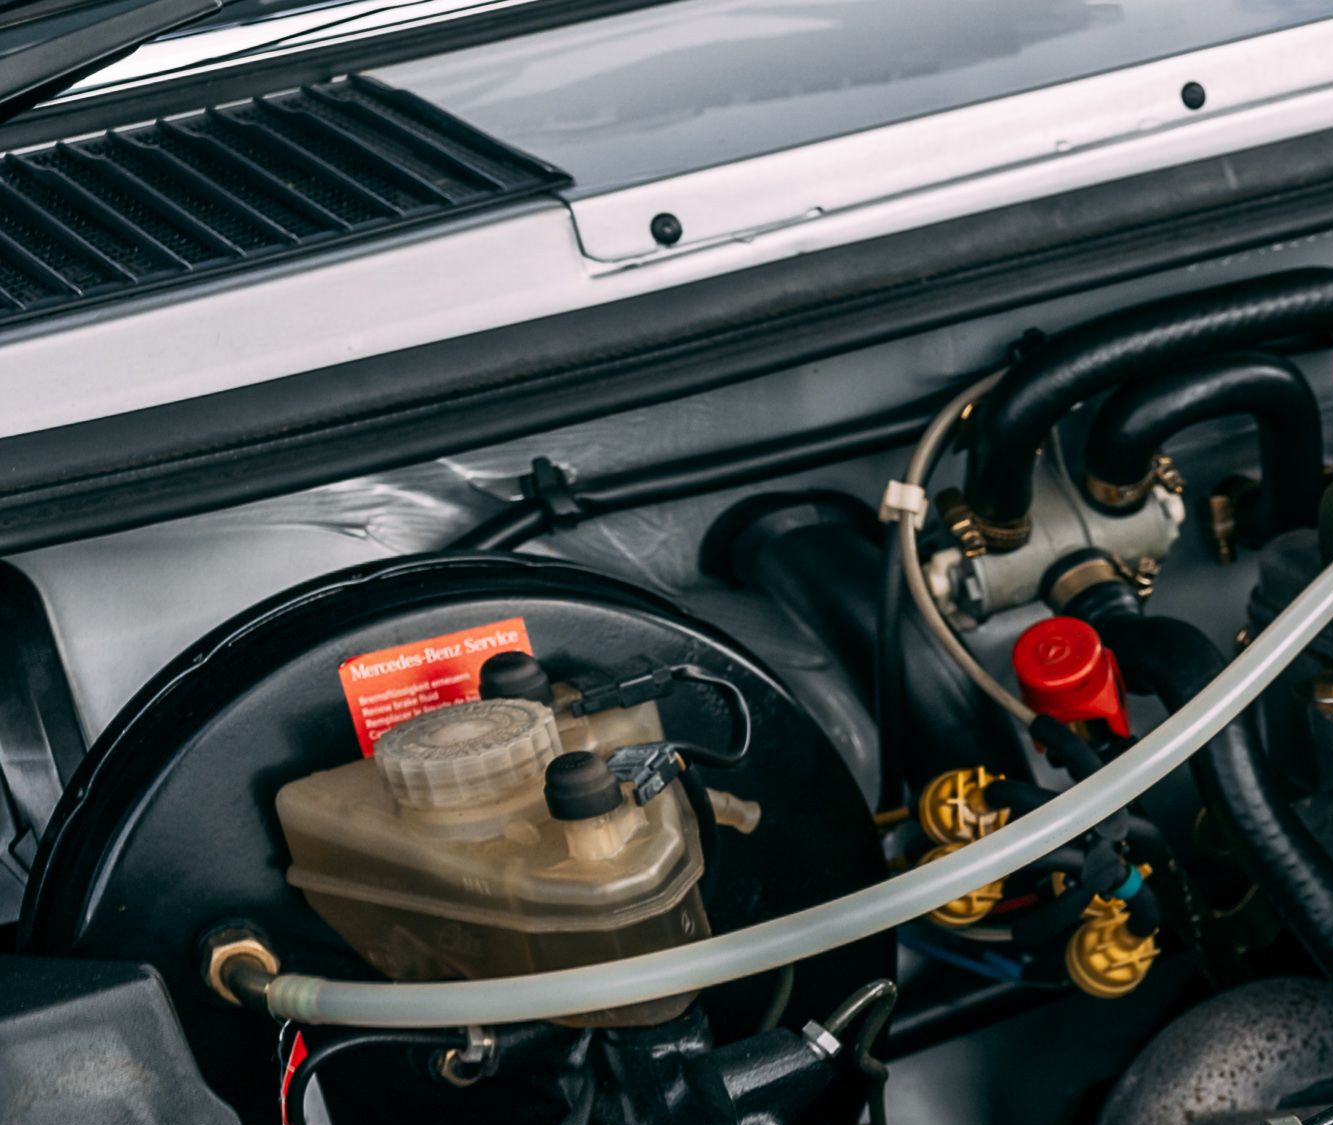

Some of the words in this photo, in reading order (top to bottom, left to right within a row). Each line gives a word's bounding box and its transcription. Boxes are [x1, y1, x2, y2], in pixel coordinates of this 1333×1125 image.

[350, 645, 460, 678] Mercedes-Benz
[464, 631, 518, 652] Service
[393, 698, 418, 709] brake
[419, 691, 439, 701] fluid
